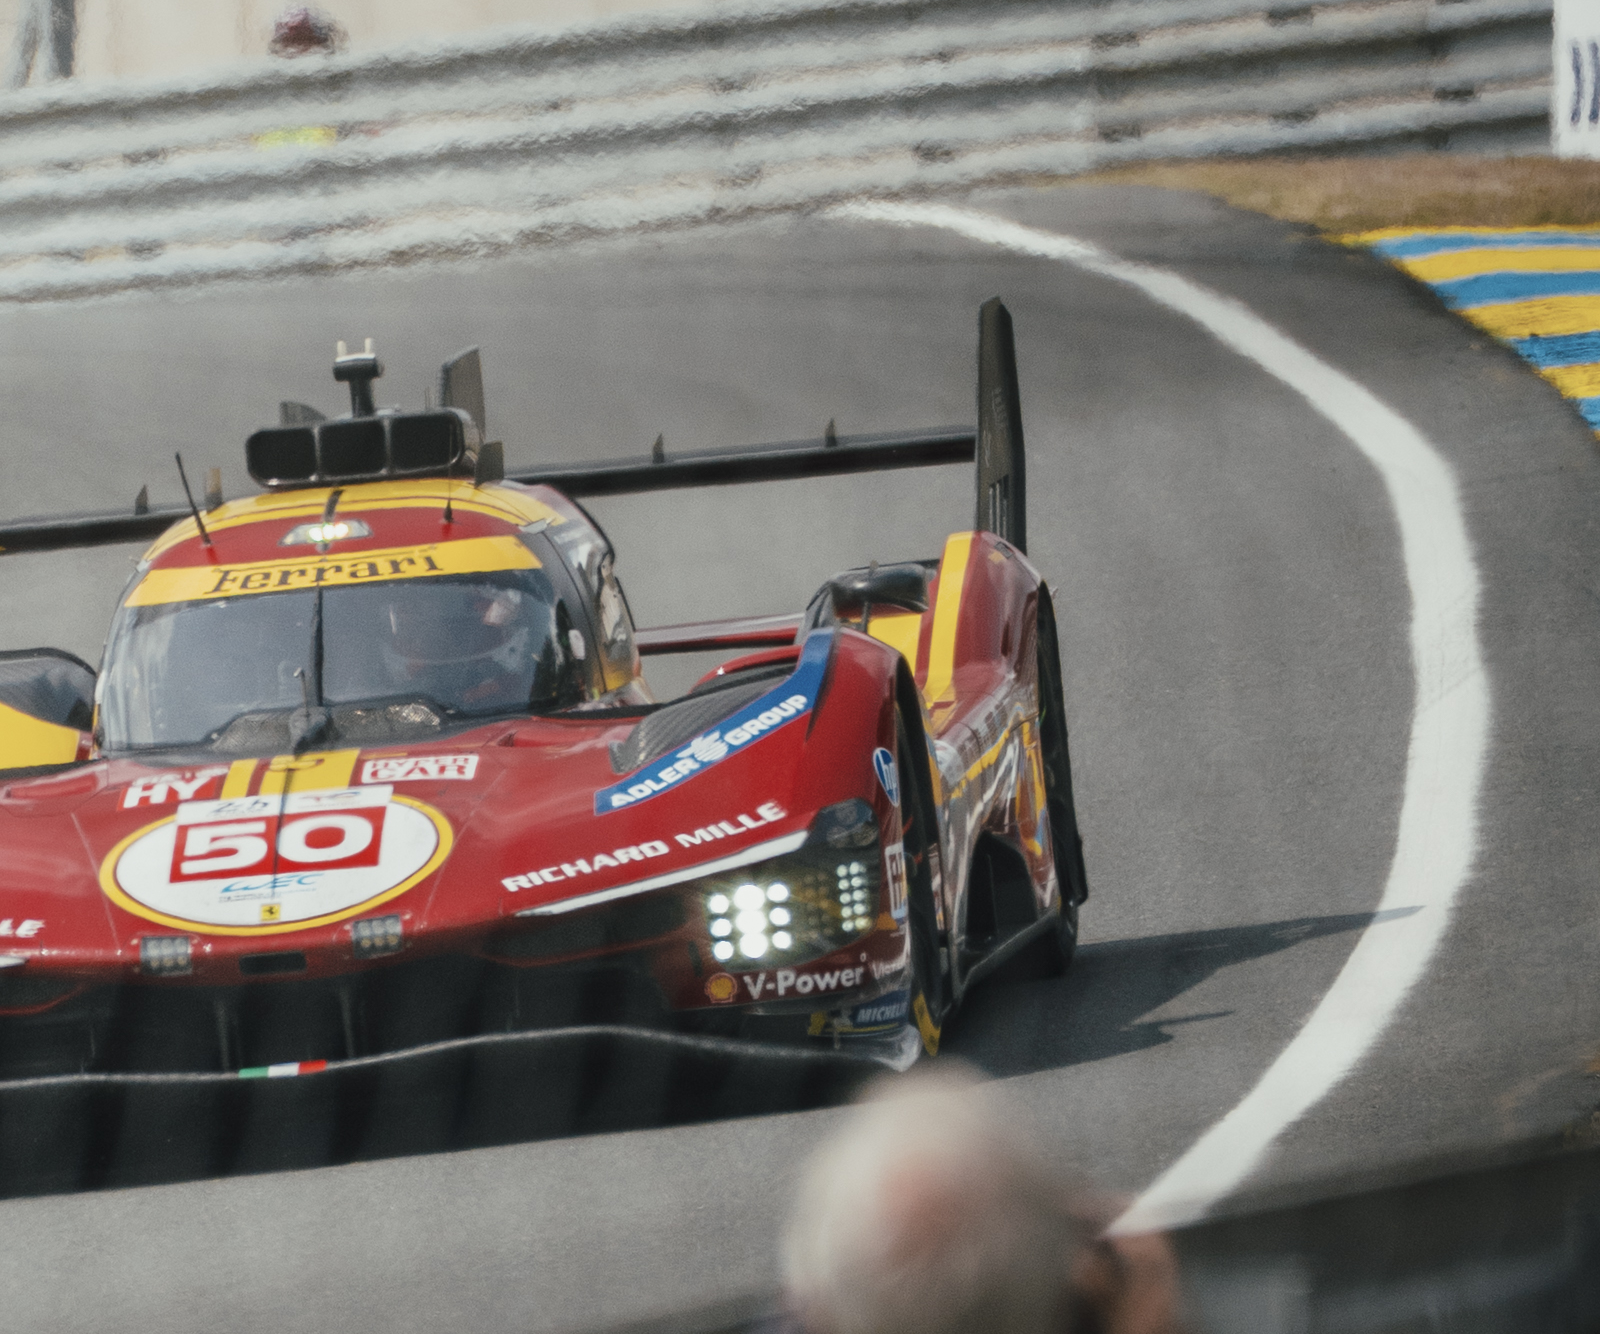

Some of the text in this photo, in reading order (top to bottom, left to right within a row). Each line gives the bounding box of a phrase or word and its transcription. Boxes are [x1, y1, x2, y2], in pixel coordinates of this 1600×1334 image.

[203, 546, 443, 594] Ferrari
[370, 764, 467, 779] CAR
[610, 695, 808, 807] ADLER GROUP
[180, 815, 373, 875] 50
[501, 801, 788, 892] RICHARD MILLE
[743, 966, 864, 1000] V-Power
